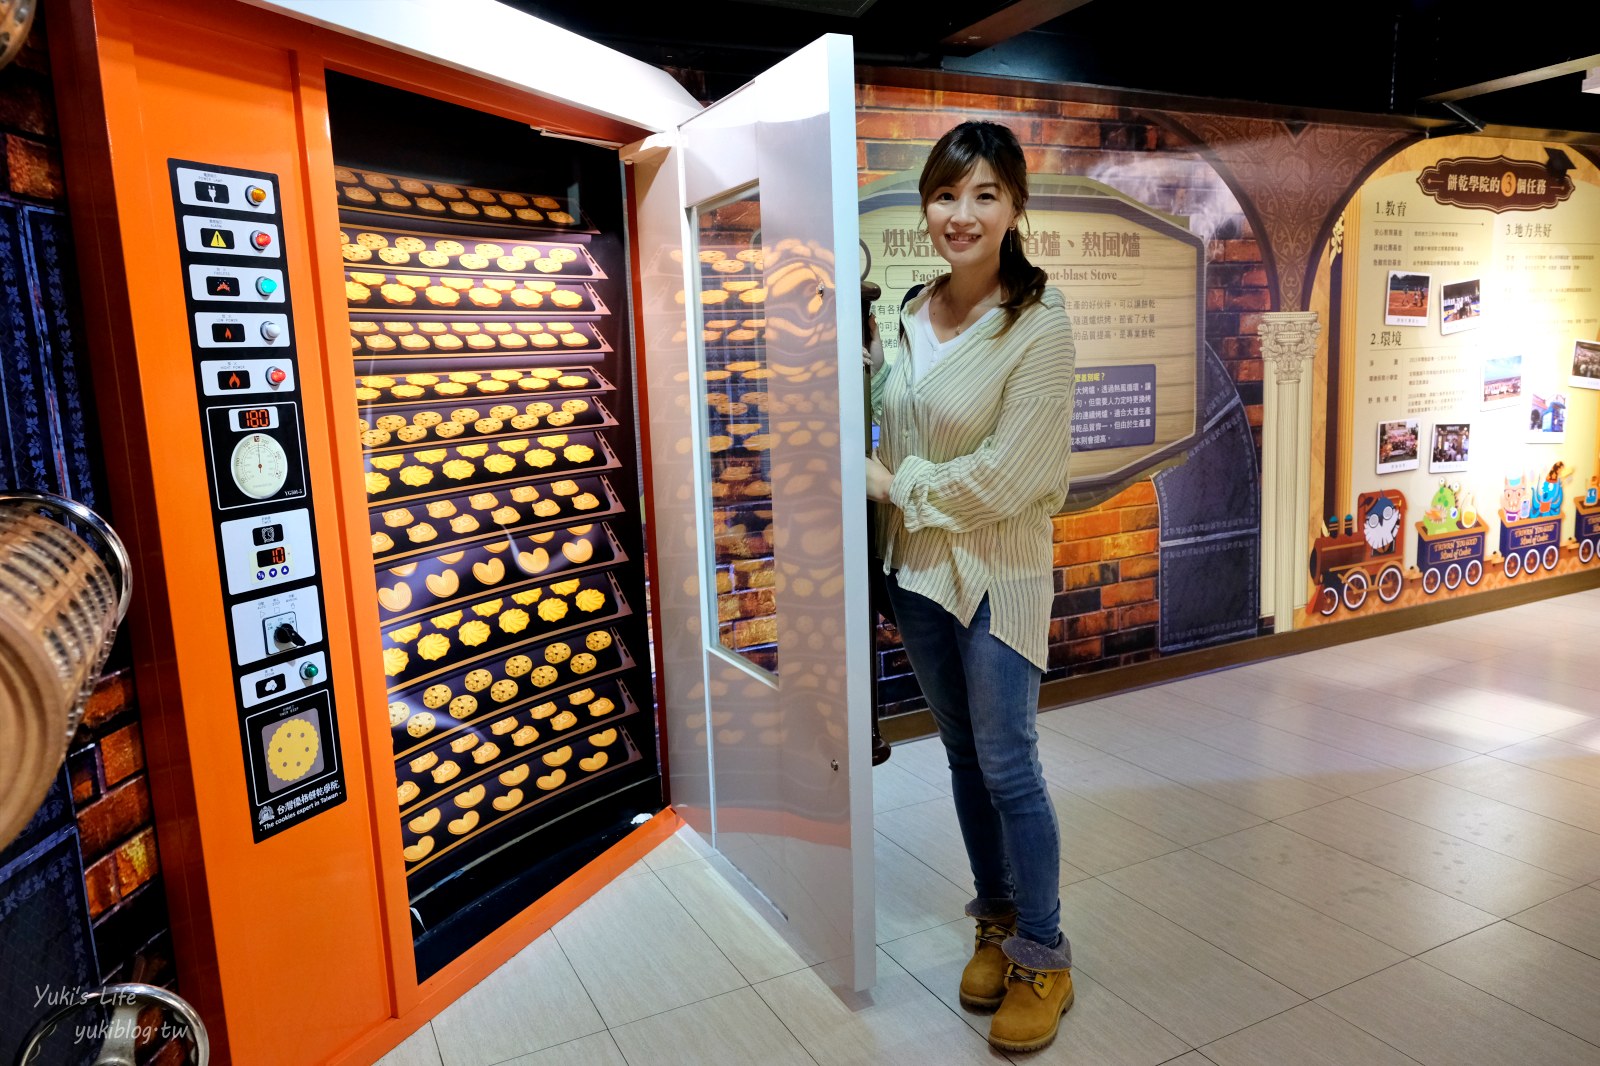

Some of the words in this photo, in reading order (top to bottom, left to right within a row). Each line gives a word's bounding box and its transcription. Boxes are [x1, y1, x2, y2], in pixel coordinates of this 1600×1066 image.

[1090, 269, 1117, 280] Stove
[1070, 314, 1155, 326] 隧道爐烘烤，節省了大量
[1071, 329, 1156, 341] 的品質提高，是專業餅乾
[1370, 330, 1402, 347] 2.環境
[1073, 395, 1151, 408] 勻，但需要人力定時更換烤
[245, 409, 269, 428] 180
[271, 547, 284, 564] 10
[263, 822, 275, 831] The
[275, 811, 296, 826] cookies
[296, 804, 314, 815] expert
[320, 792, 339, 803] Taiwan
